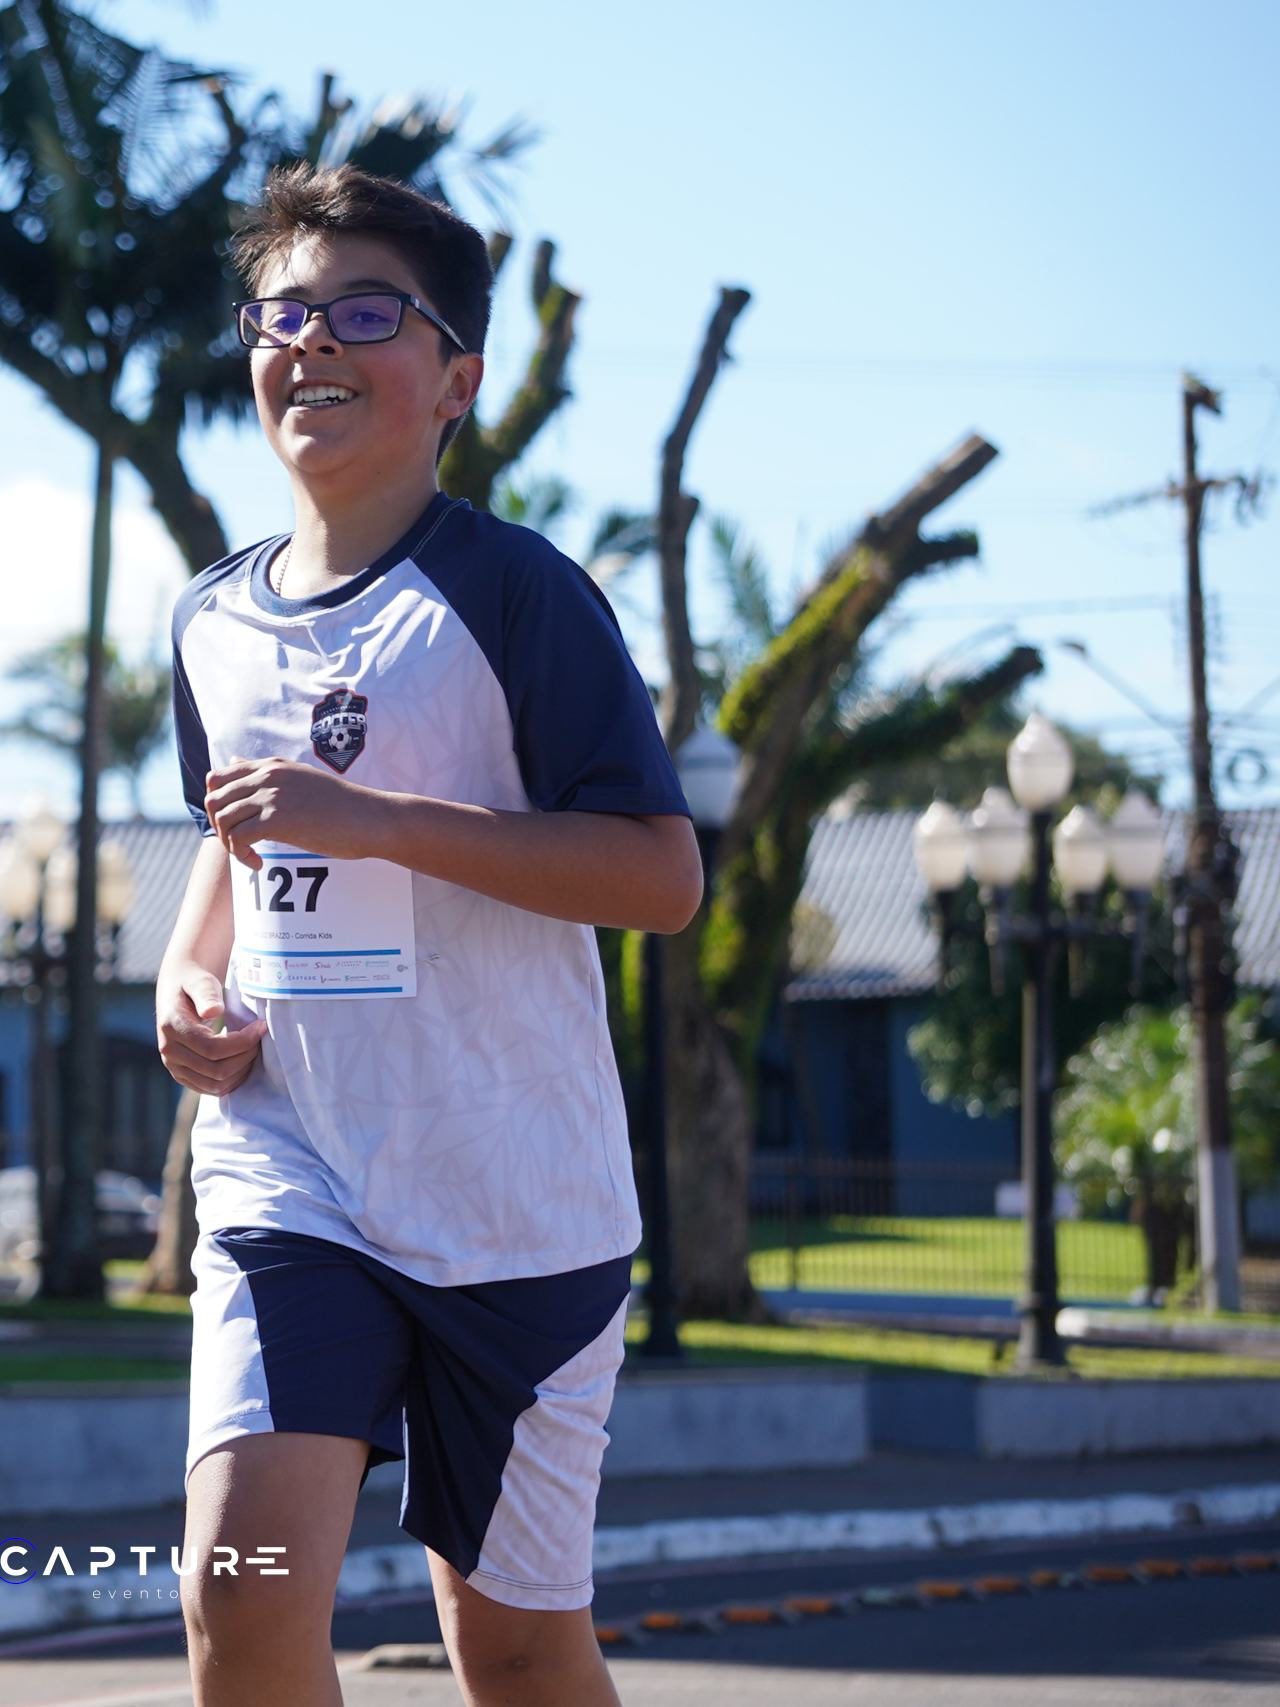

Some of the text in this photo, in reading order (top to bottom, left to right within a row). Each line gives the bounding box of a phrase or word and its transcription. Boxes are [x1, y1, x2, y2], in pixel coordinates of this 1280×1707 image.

[311, 712, 367, 736] SOCCER
[249, 866, 329, 913] 127
[268, 931, 290, 940] BRAZZO
[294, 932, 317, 940] Corrida
[318, 931, 333, 940] Kids
